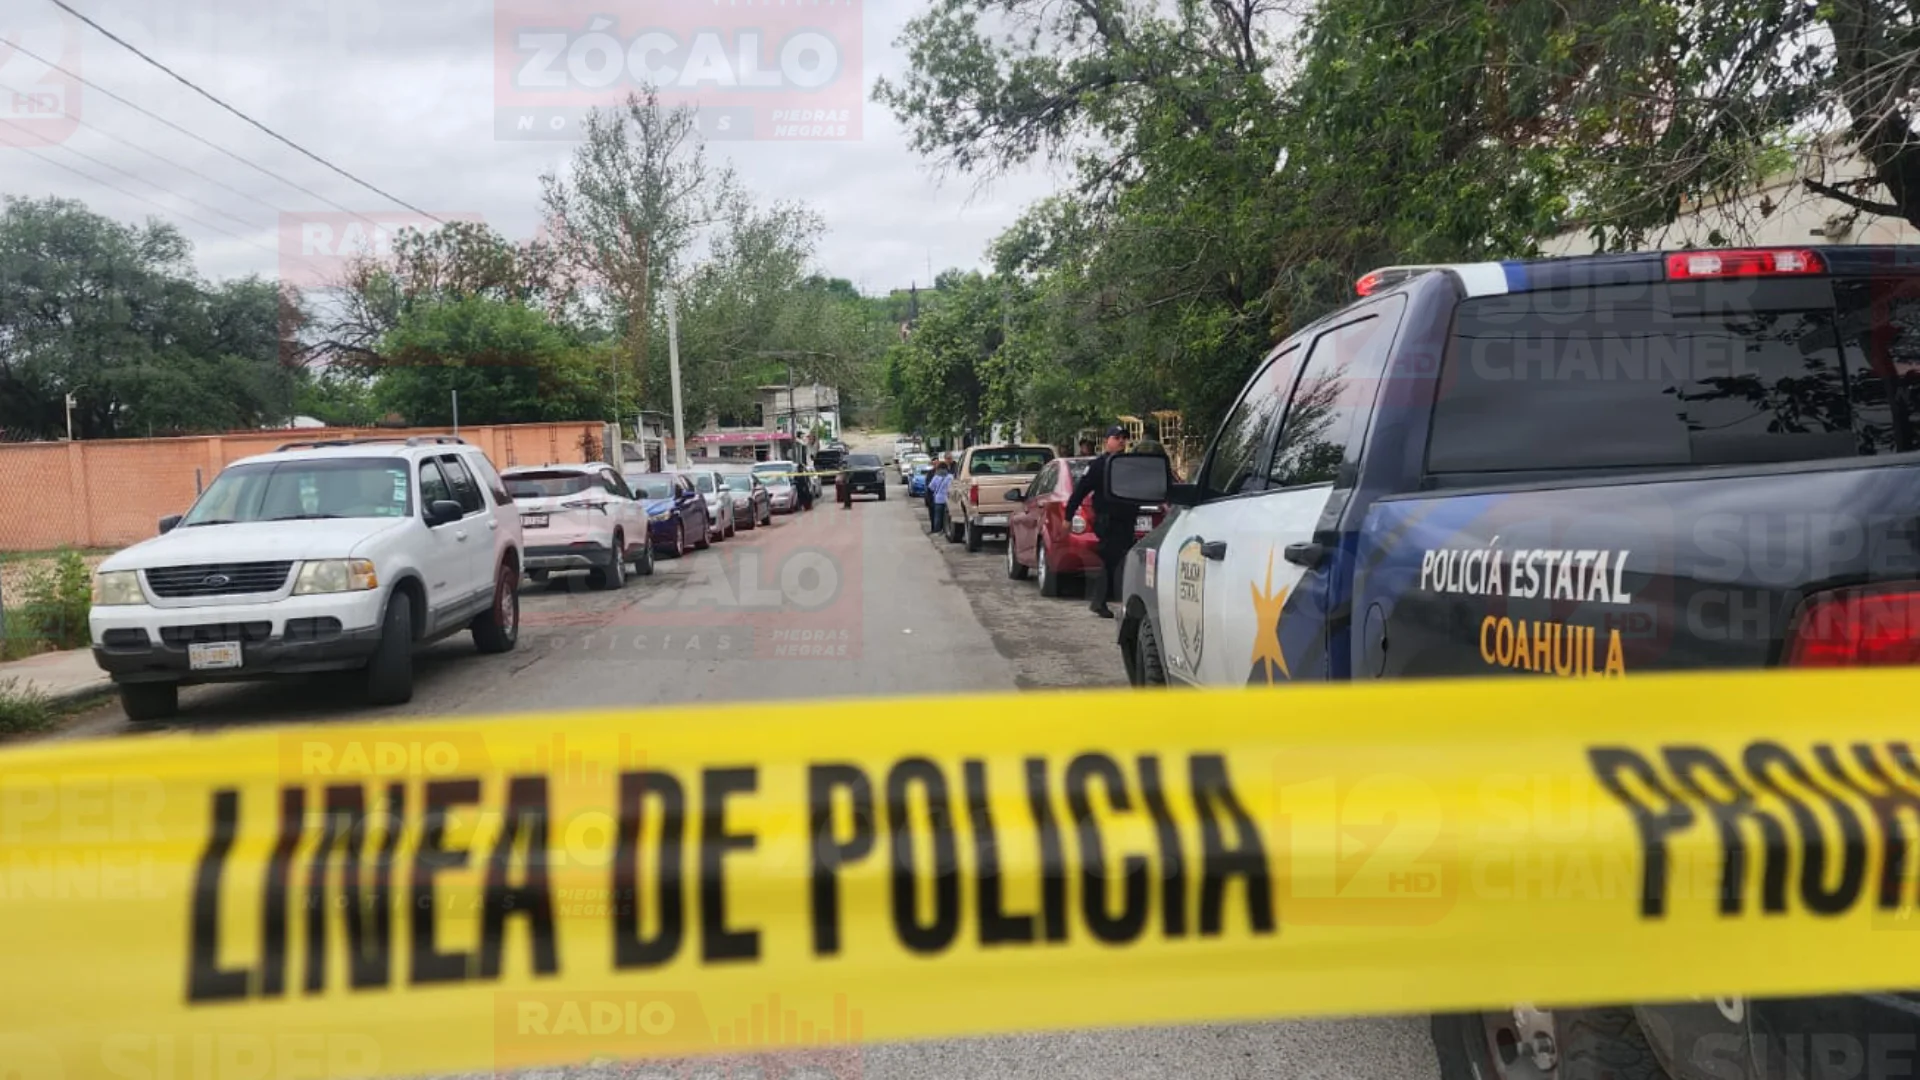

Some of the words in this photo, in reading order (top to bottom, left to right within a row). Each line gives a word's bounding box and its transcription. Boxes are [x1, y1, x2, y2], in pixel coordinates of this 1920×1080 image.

[1421, 536, 1504, 596] POLICÍA
[1509, 549, 1632, 604] ESTATAL
[1480, 615, 1627, 678] COAHUILA
[186, 773, 563, 1004] LINEA
[611, 765, 763, 972] DE
[808, 754, 1277, 957] POLICIA
